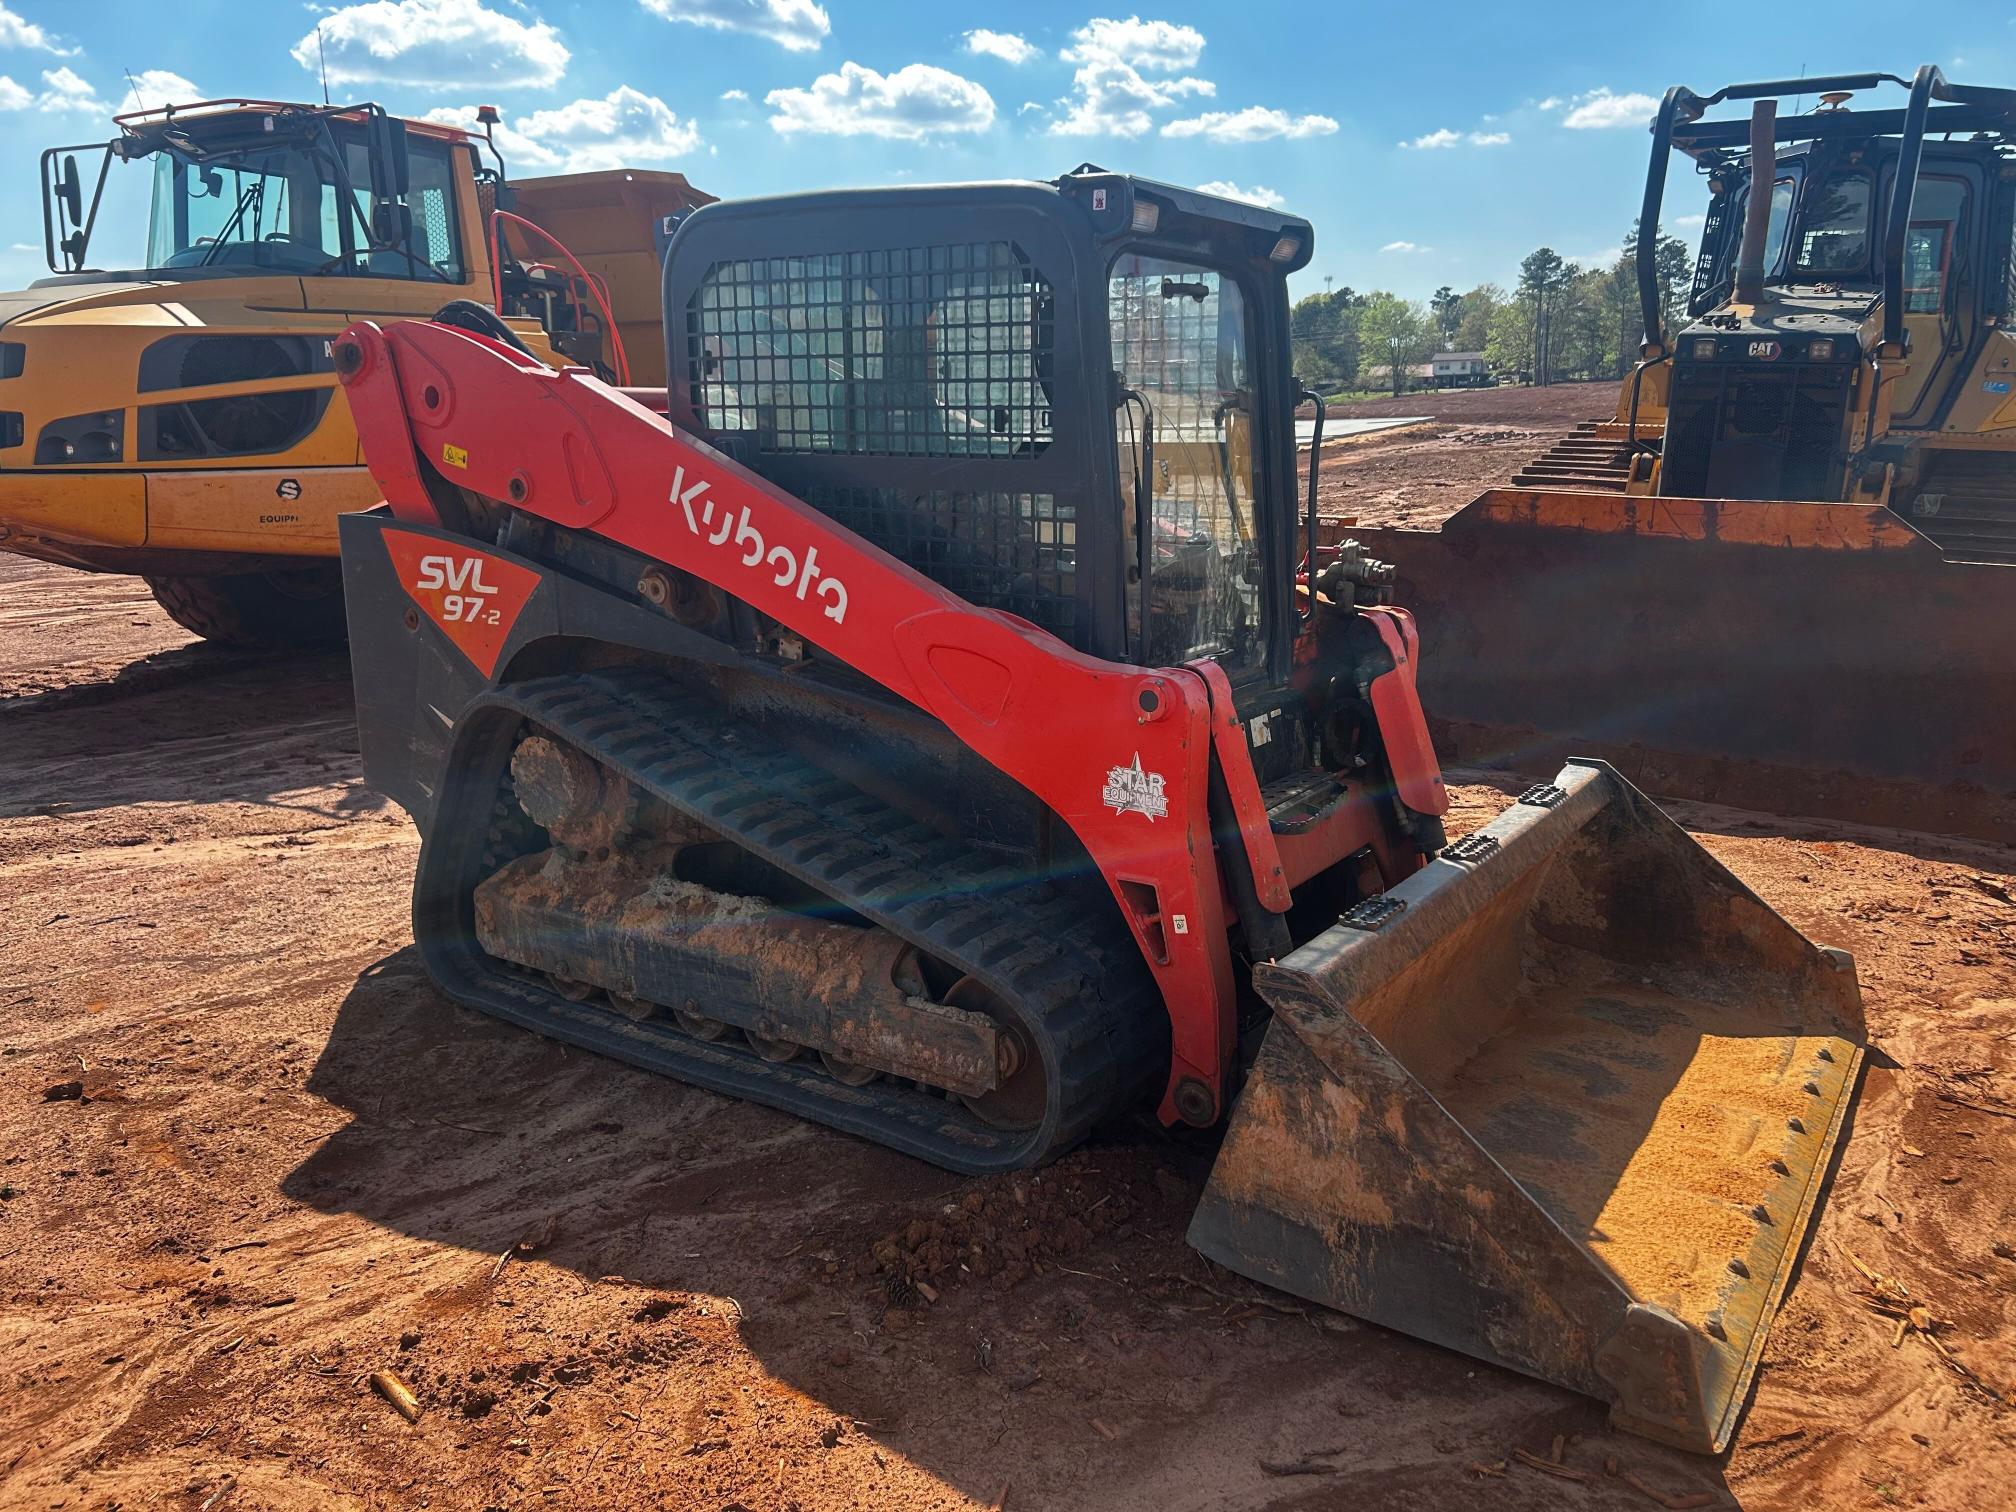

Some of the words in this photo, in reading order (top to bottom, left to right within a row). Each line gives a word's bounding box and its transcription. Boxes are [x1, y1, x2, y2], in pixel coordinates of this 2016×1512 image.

[1748, 341, 1774, 357] CAT
[668, 464, 849, 625] Kubota
[416, 554, 499, 595] SVL
[443, 594, 501, 626] 97-2
[1108, 766, 1164, 797] STAR
[1103, 786, 1168, 812] EQUIPMENT
